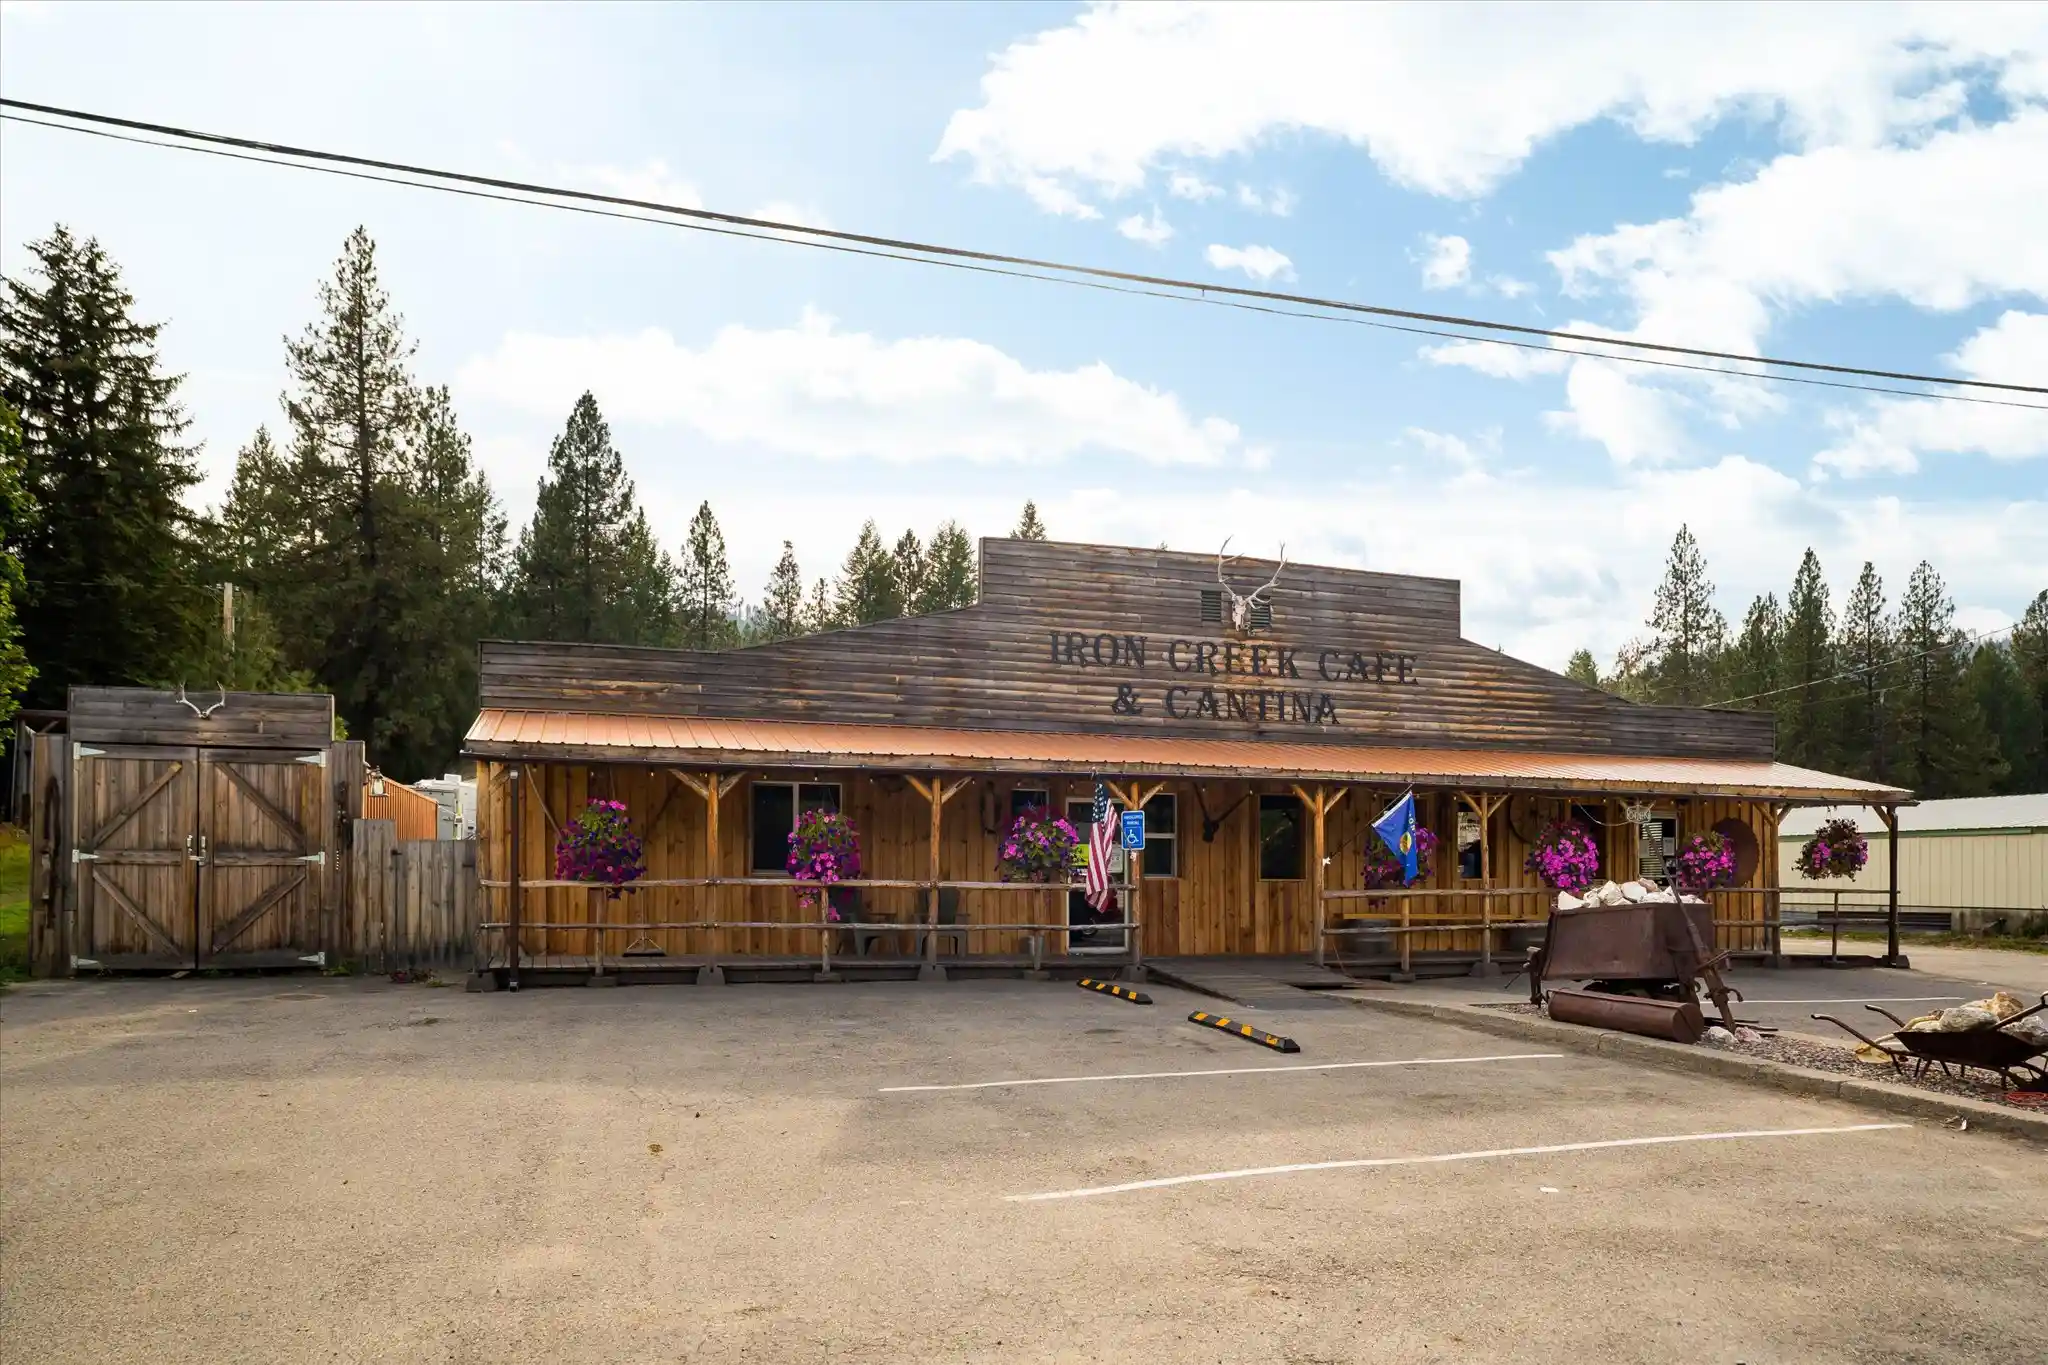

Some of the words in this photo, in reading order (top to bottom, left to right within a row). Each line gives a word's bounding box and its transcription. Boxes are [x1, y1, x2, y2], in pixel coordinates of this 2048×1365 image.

[1050, 630, 1148, 669] IRON
[1168, 639, 1301, 679] CREEK
[1318, 649, 1420, 686] CAFE
[1111, 683, 1143, 715] &
[1166, 685, 1341, 725] CANTINA
